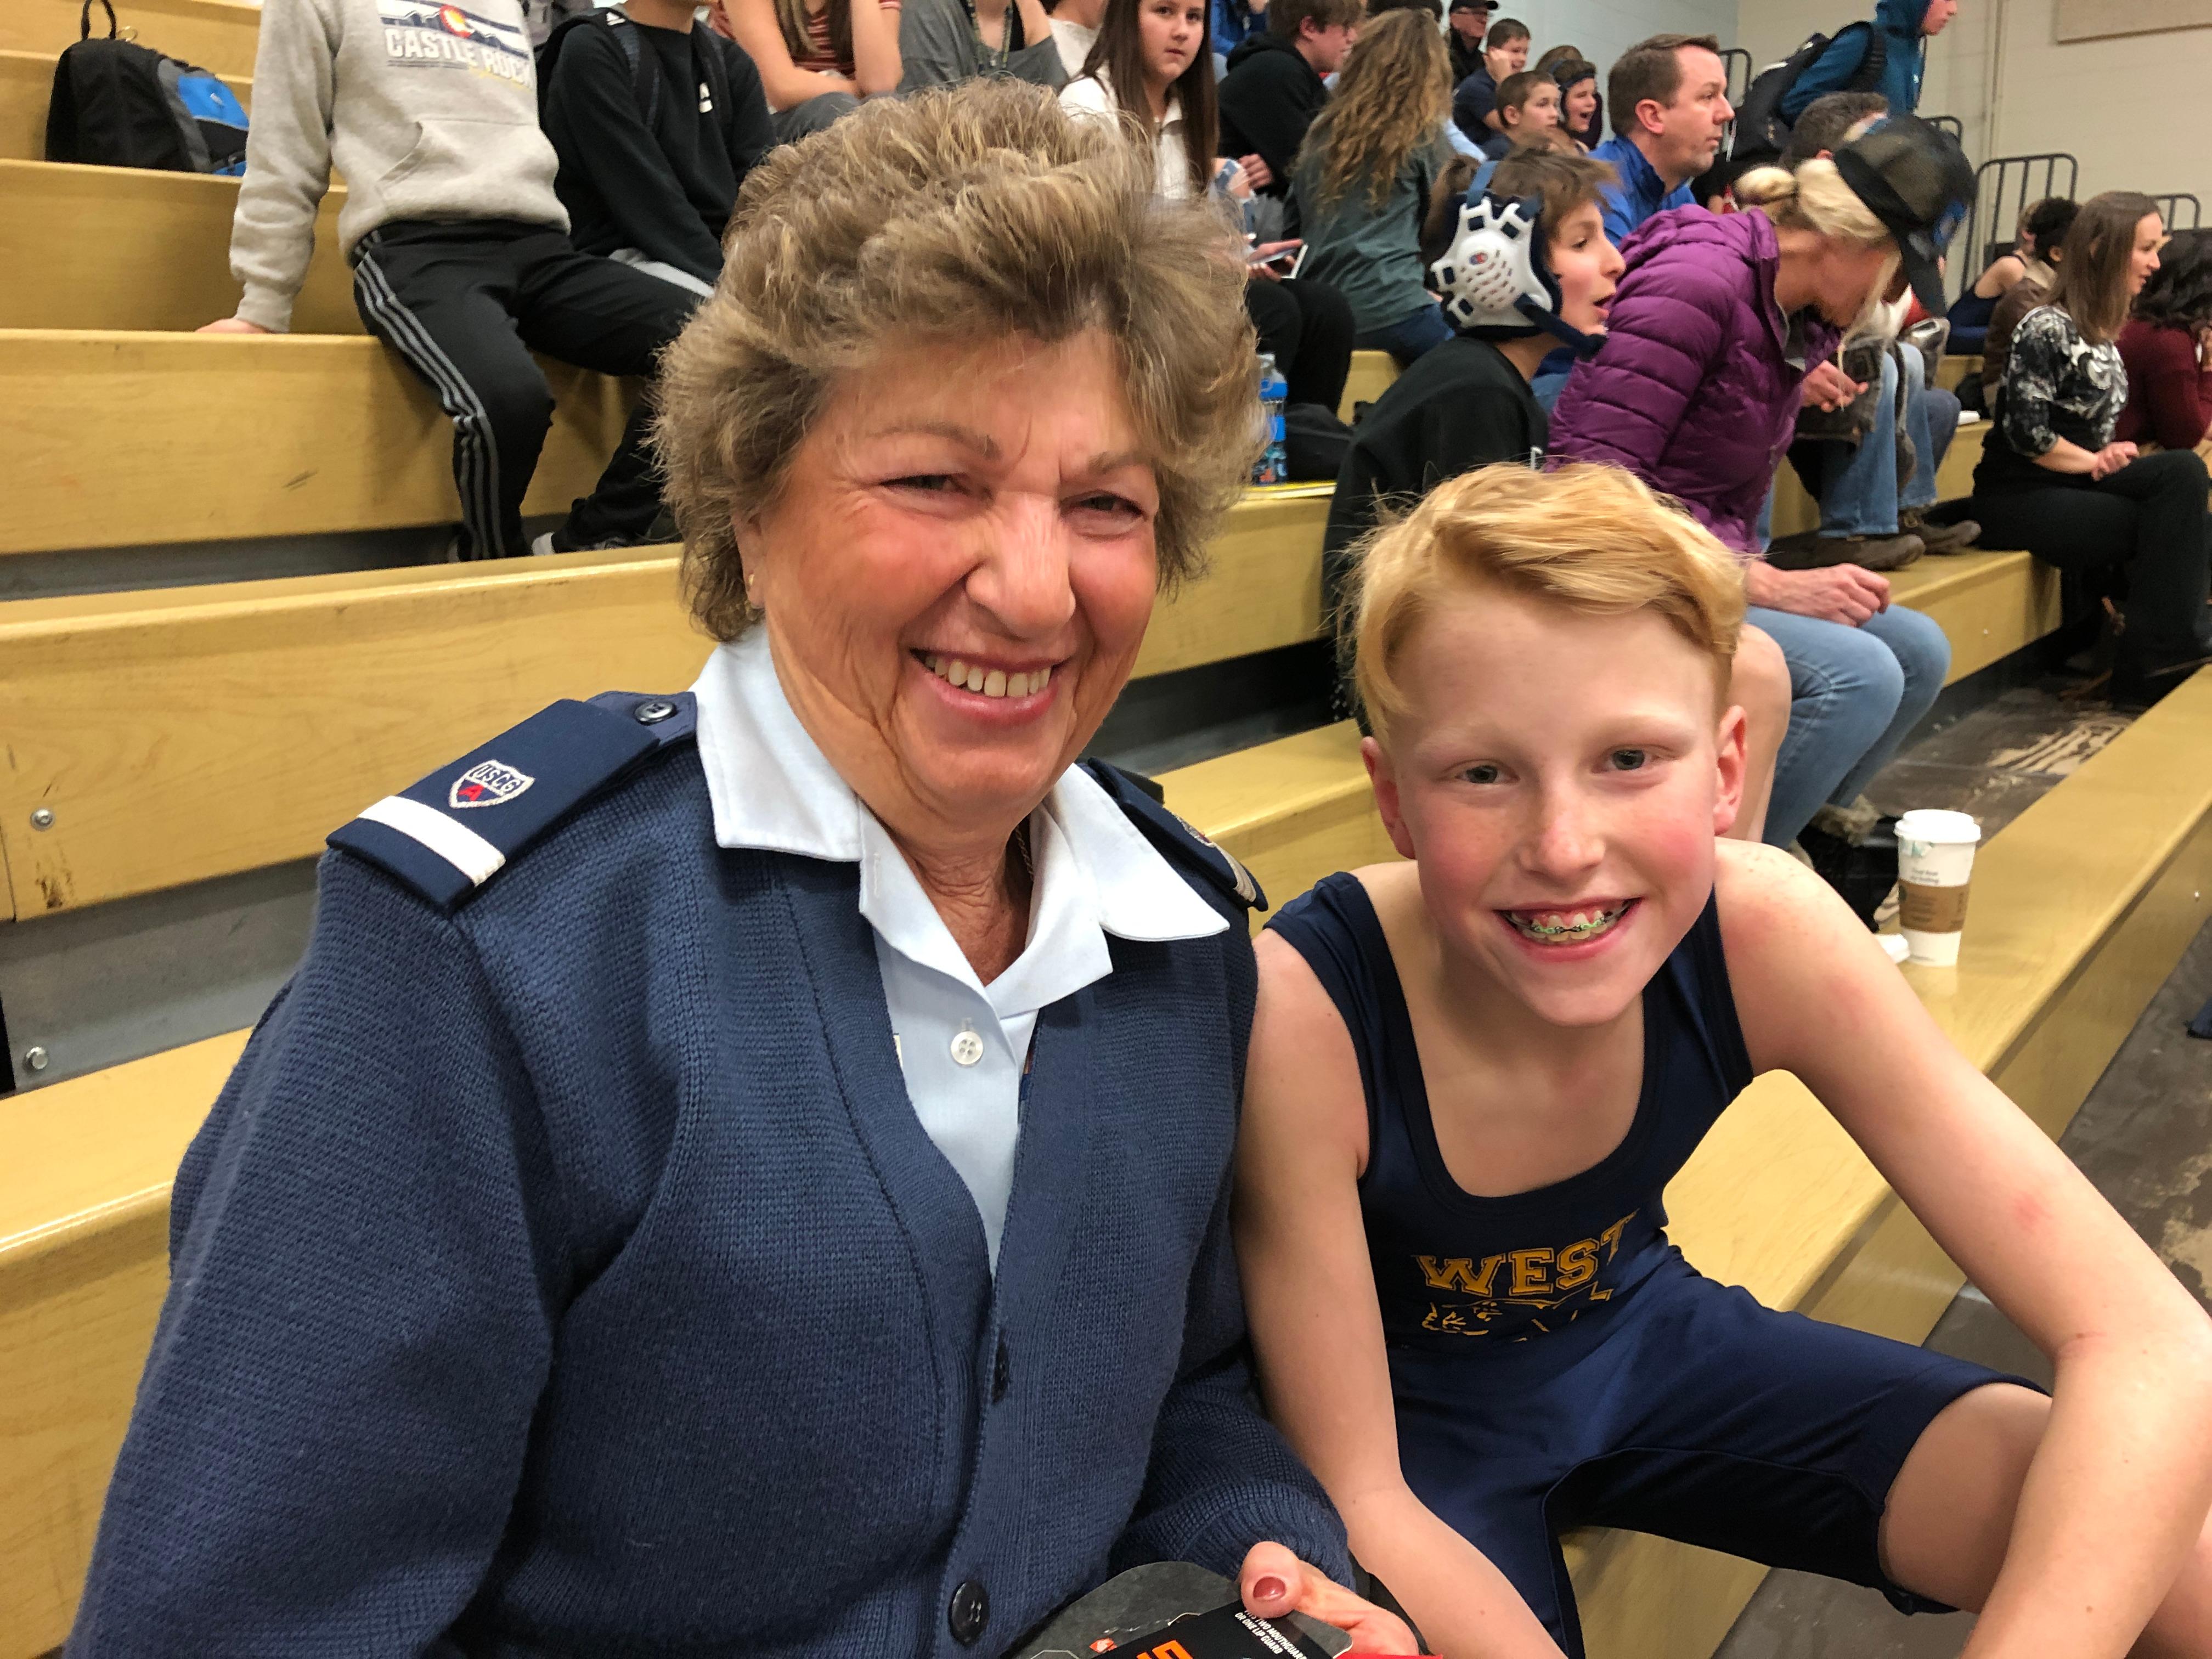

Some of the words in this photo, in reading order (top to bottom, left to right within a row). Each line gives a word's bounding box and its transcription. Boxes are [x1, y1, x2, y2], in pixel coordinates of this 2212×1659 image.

[385, 29, 477, 67] CASTLE
[472, 765, 520, 792] USCG
[1411, 1208, 1640, 1297] WEST
[1234, 1612, 1246, 1621] OR
[1242, 1618, 1257, 1630] ONE
[1251, 1627, 1266, 1637] LIP
[1261, 1635, 1283, 1655] GUARD
[1255, 1618, 1271, 1630] TWO
